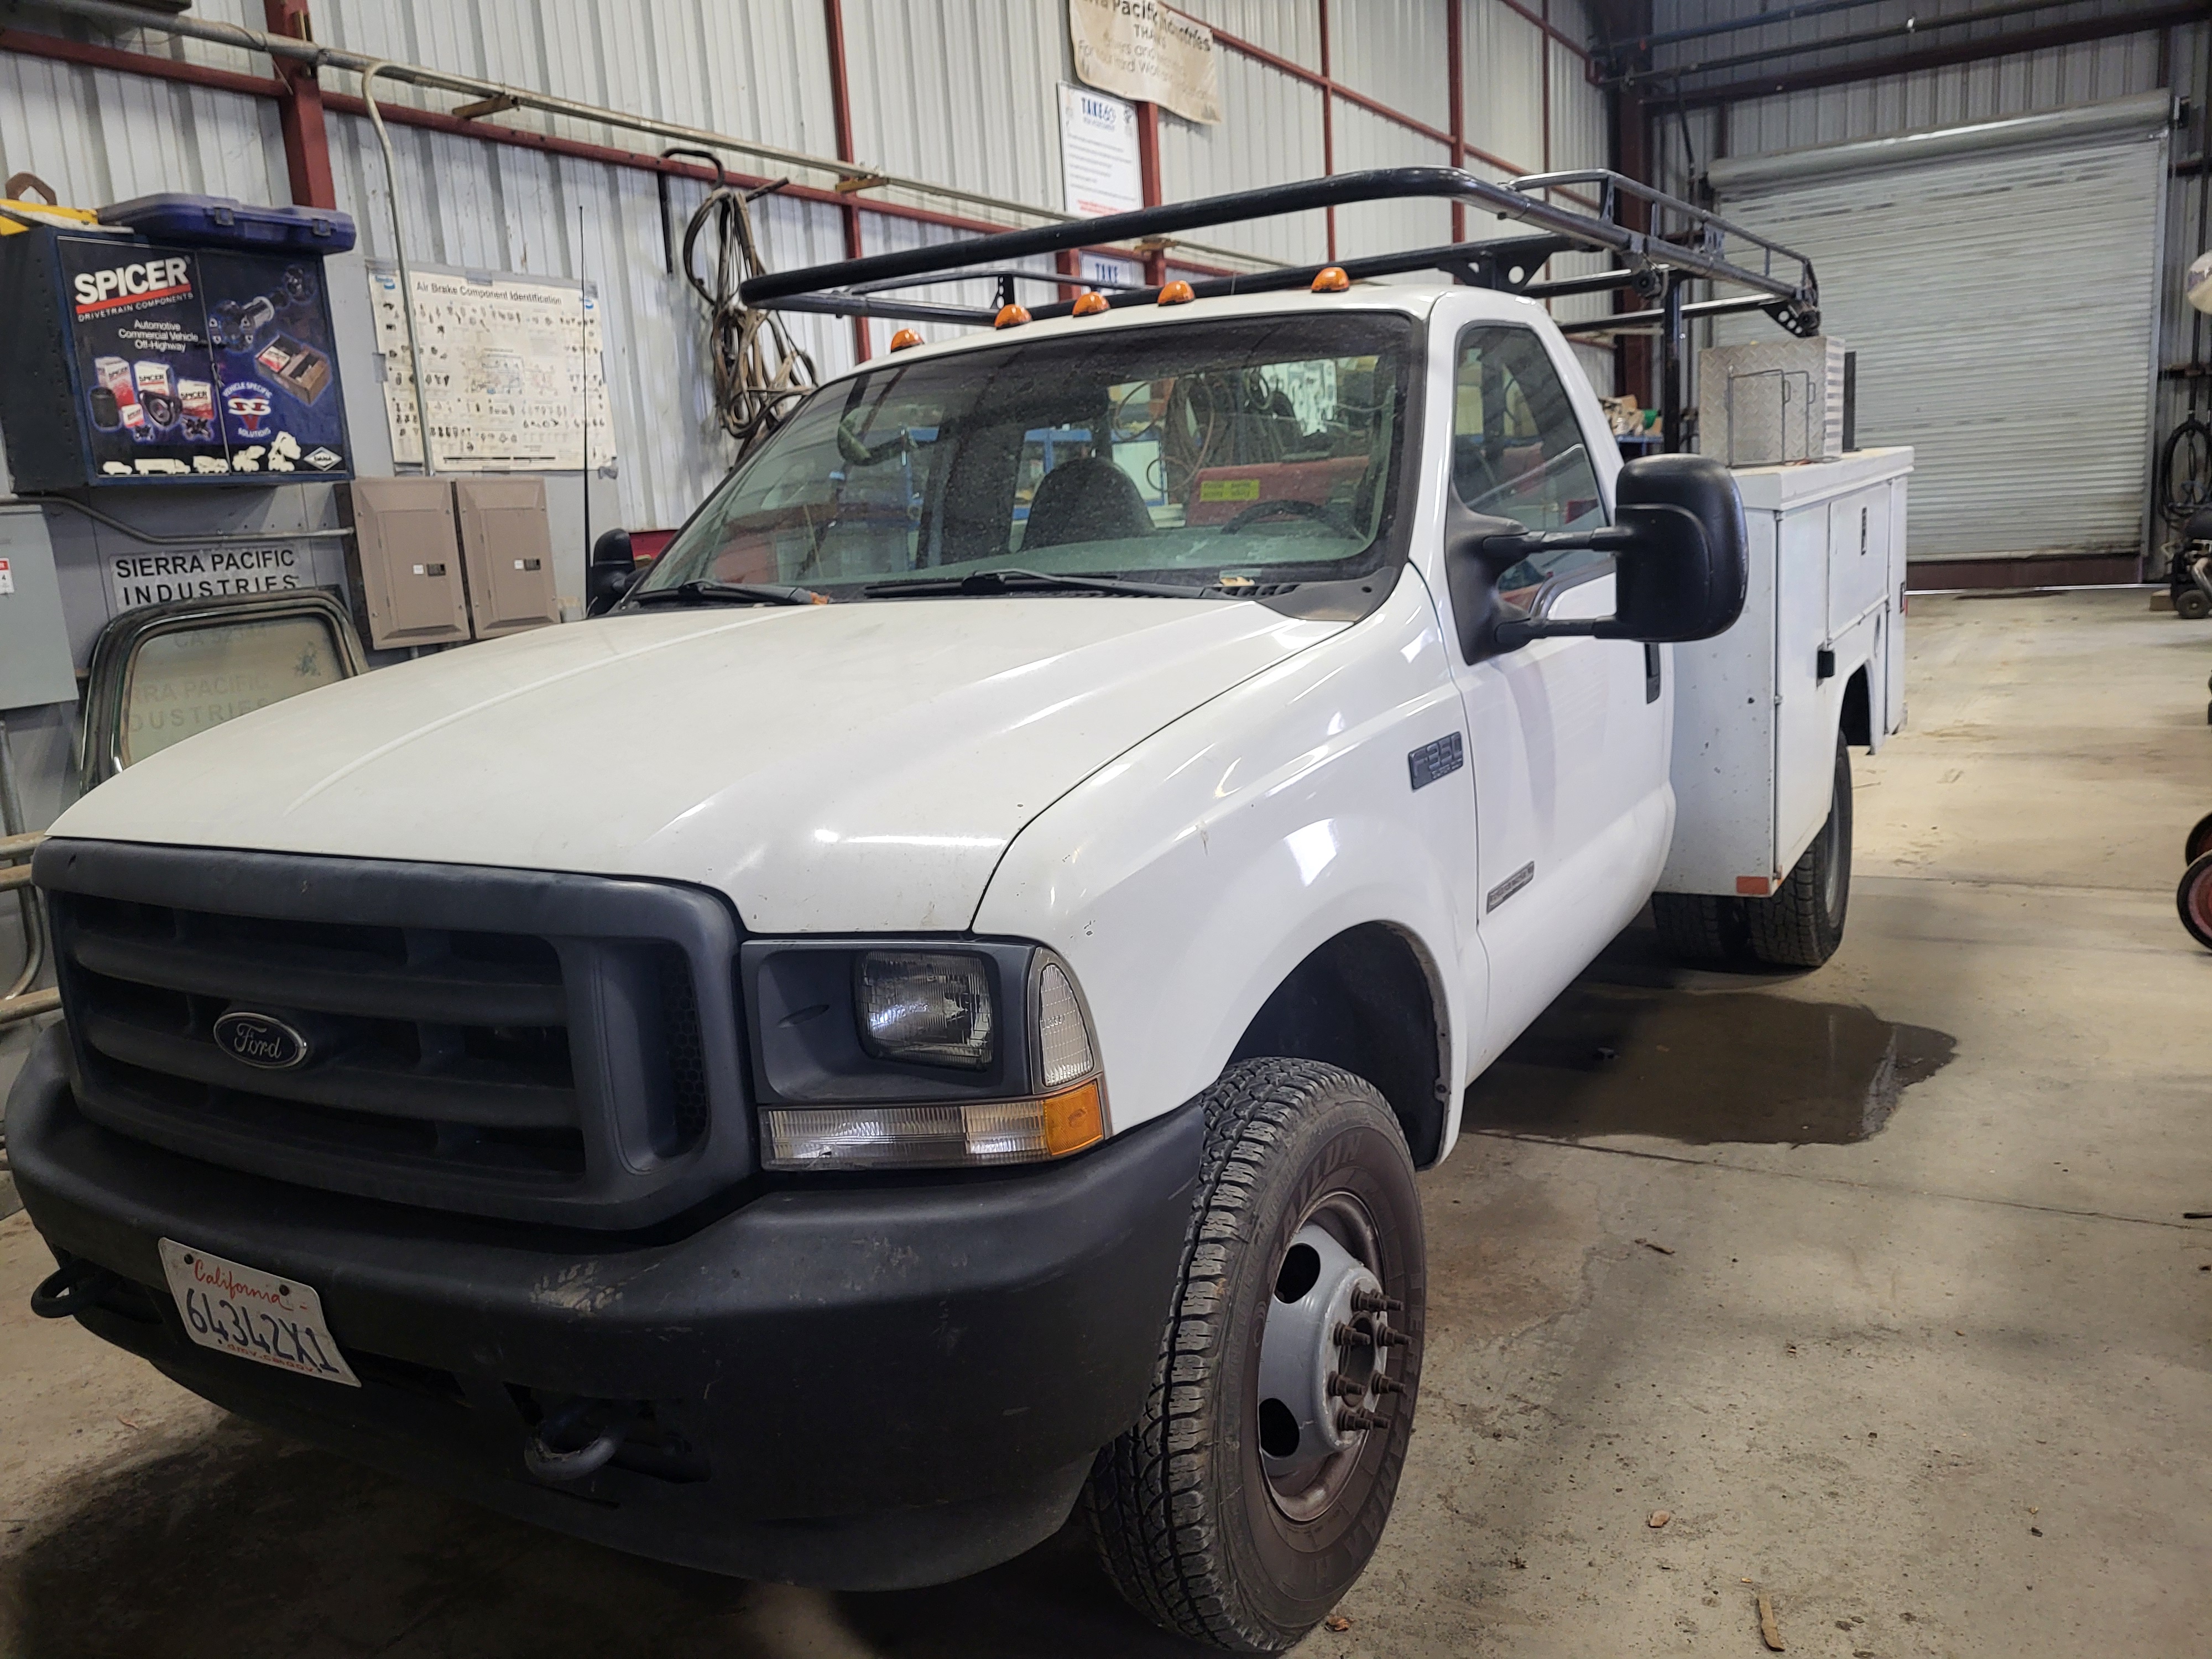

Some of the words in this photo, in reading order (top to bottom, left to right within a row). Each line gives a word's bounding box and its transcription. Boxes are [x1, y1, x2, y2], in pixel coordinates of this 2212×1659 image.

[74, 257, 190, 305] SPICER
[416, 281, 429, 291] Air
[431, 283, 458, 295] Brake
[460, 285, 508, 300] Component
[509, 291, 562, 305] Identification
[77, 304, 133, 322] DRIVETRAIN
[135, 292, 194, 310] COMPONENTS
[118, 328, 169, 341] Commercial
[169, 331, 199, 342] Vehicle
[134, 319, 181, 331] Automotive
[116, 555, 205, 578] SIERRA
[211, 550, 295, 572] PACIFIC
[123, 574, 298, 606] INDUSTRIES
[234, 1023, 282, 1058] Ford
[194, 1259, 294, 1311] California
[186, 1288, 340, 1374] 64342X1
